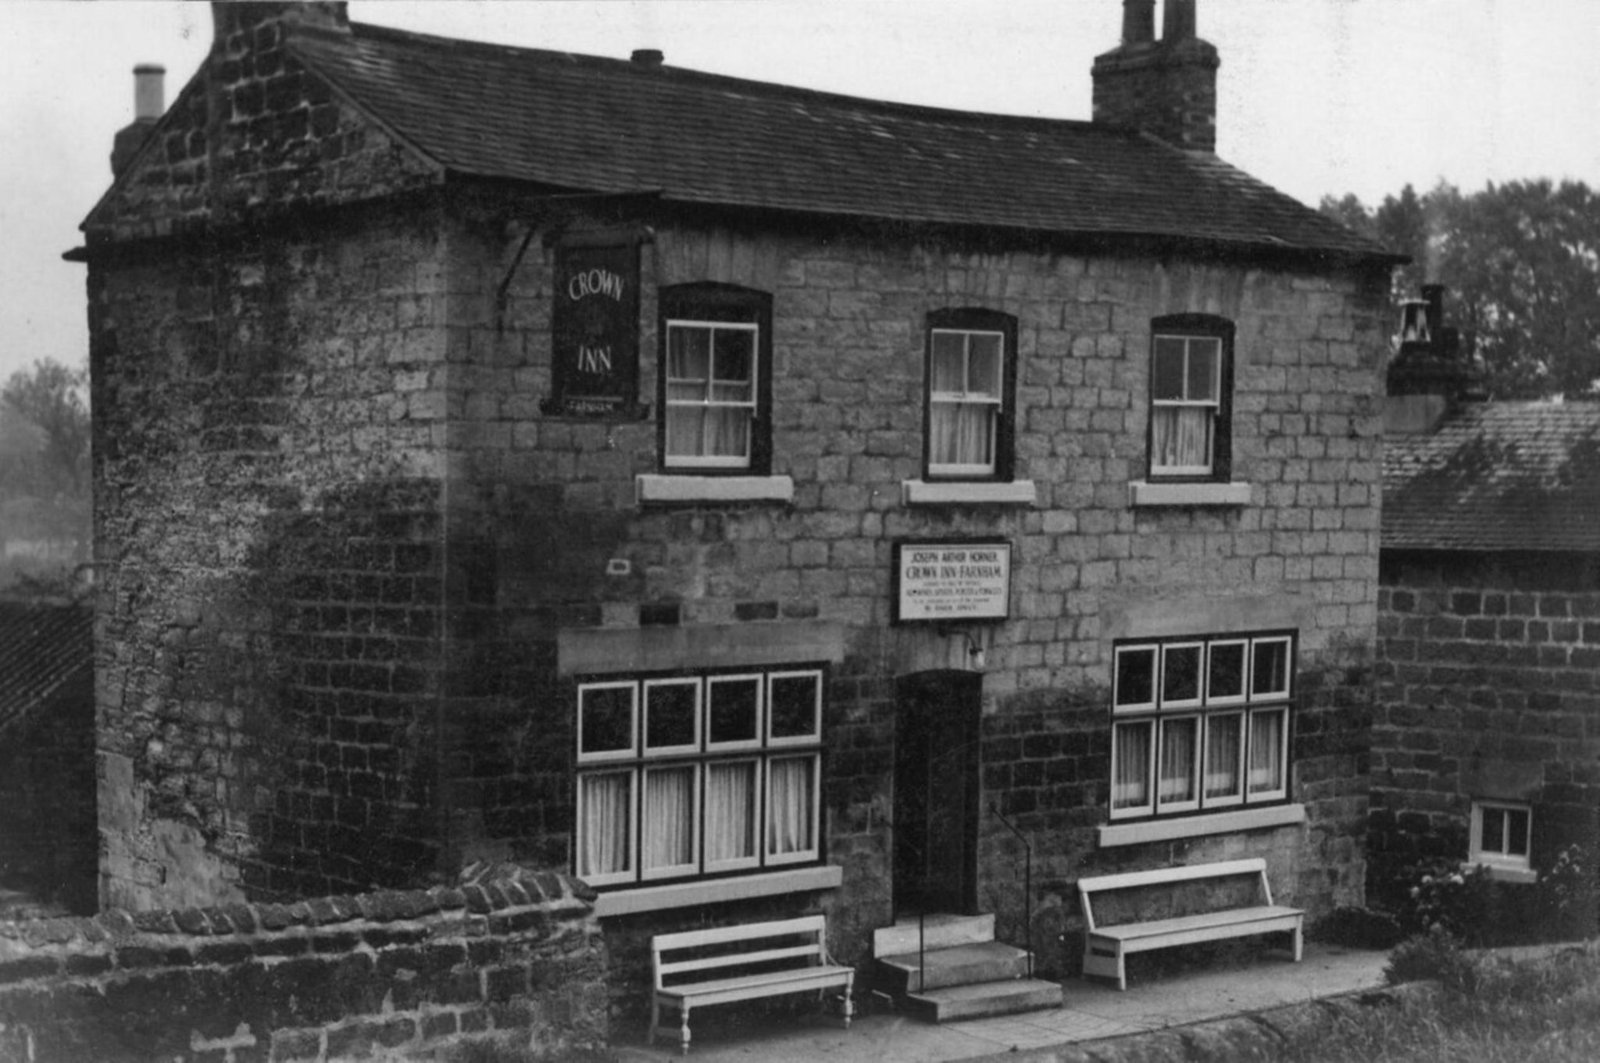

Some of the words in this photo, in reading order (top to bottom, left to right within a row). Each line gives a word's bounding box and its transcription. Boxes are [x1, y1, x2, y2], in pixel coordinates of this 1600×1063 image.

[568, 268, 625, 302] CROWN
[577, 345, 612, 373] INN
[906, 566, 937, 580] CROWN
